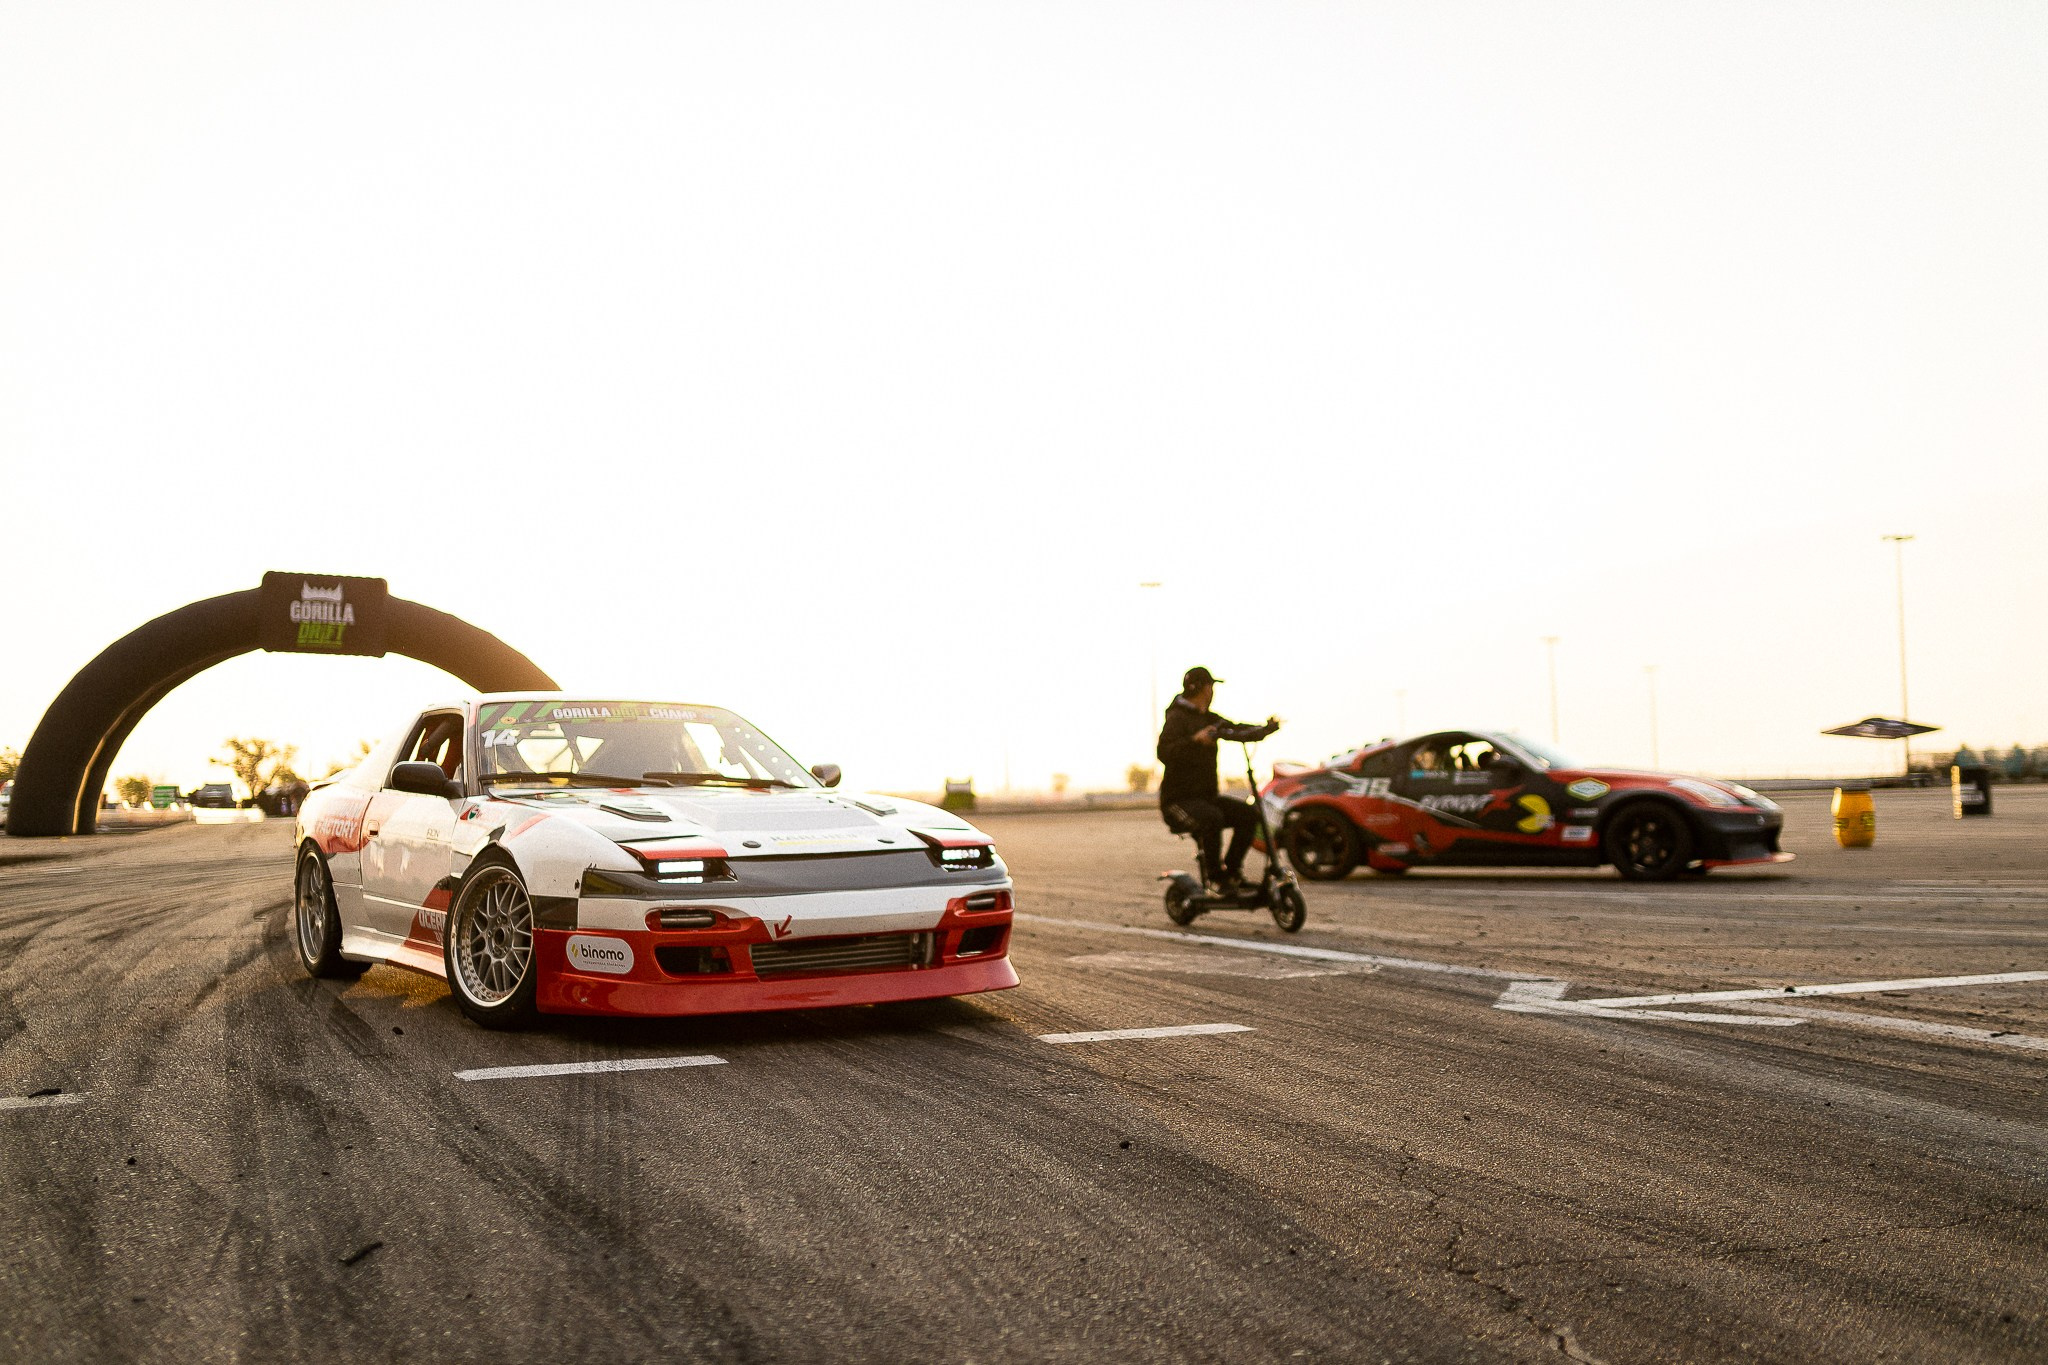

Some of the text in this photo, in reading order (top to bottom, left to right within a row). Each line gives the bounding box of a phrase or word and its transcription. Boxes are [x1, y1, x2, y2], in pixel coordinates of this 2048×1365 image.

[290, 600, 354, 625] GORILLA
[297, 621, 346, 643] DRIFT
[553, 707, 611, 719] GORILLA
[481, 729, 518, 748] 14
[315, 817, 358, 839] FACTORY
[580, 944, 625, 961] binomo
